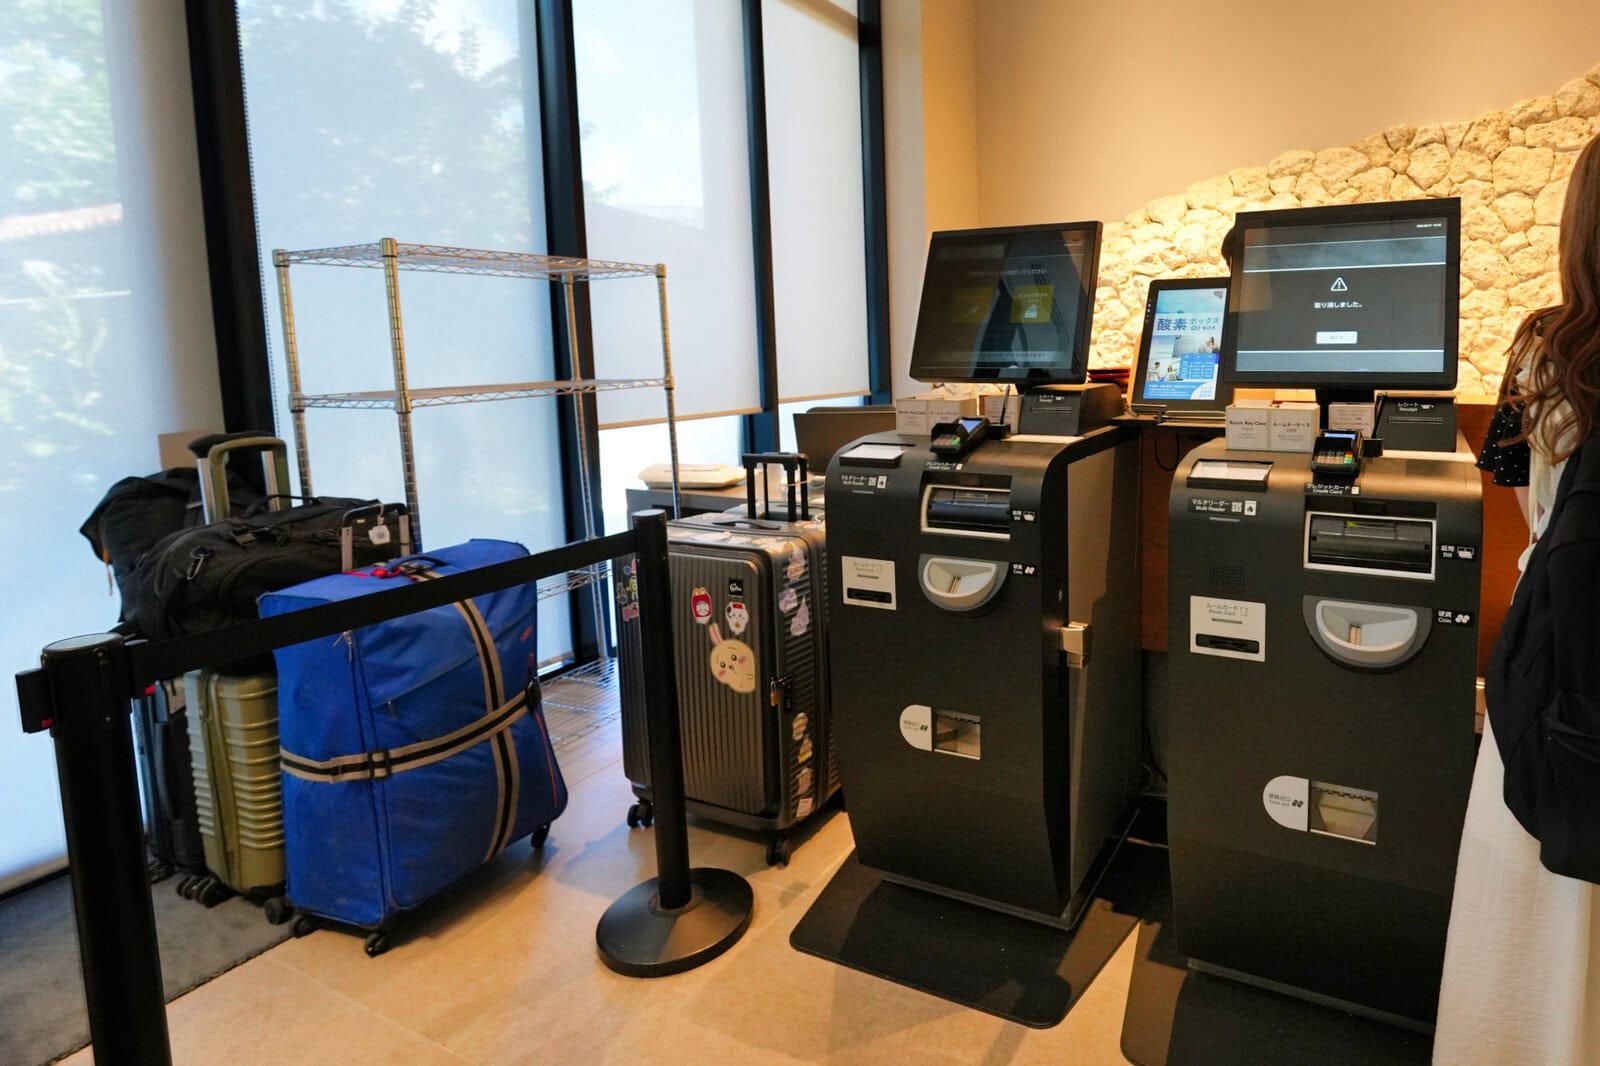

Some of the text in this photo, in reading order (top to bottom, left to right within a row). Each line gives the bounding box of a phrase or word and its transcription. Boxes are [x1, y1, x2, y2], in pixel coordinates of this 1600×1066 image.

[1157, 317, 1220, 331] 酸素 ボックス
